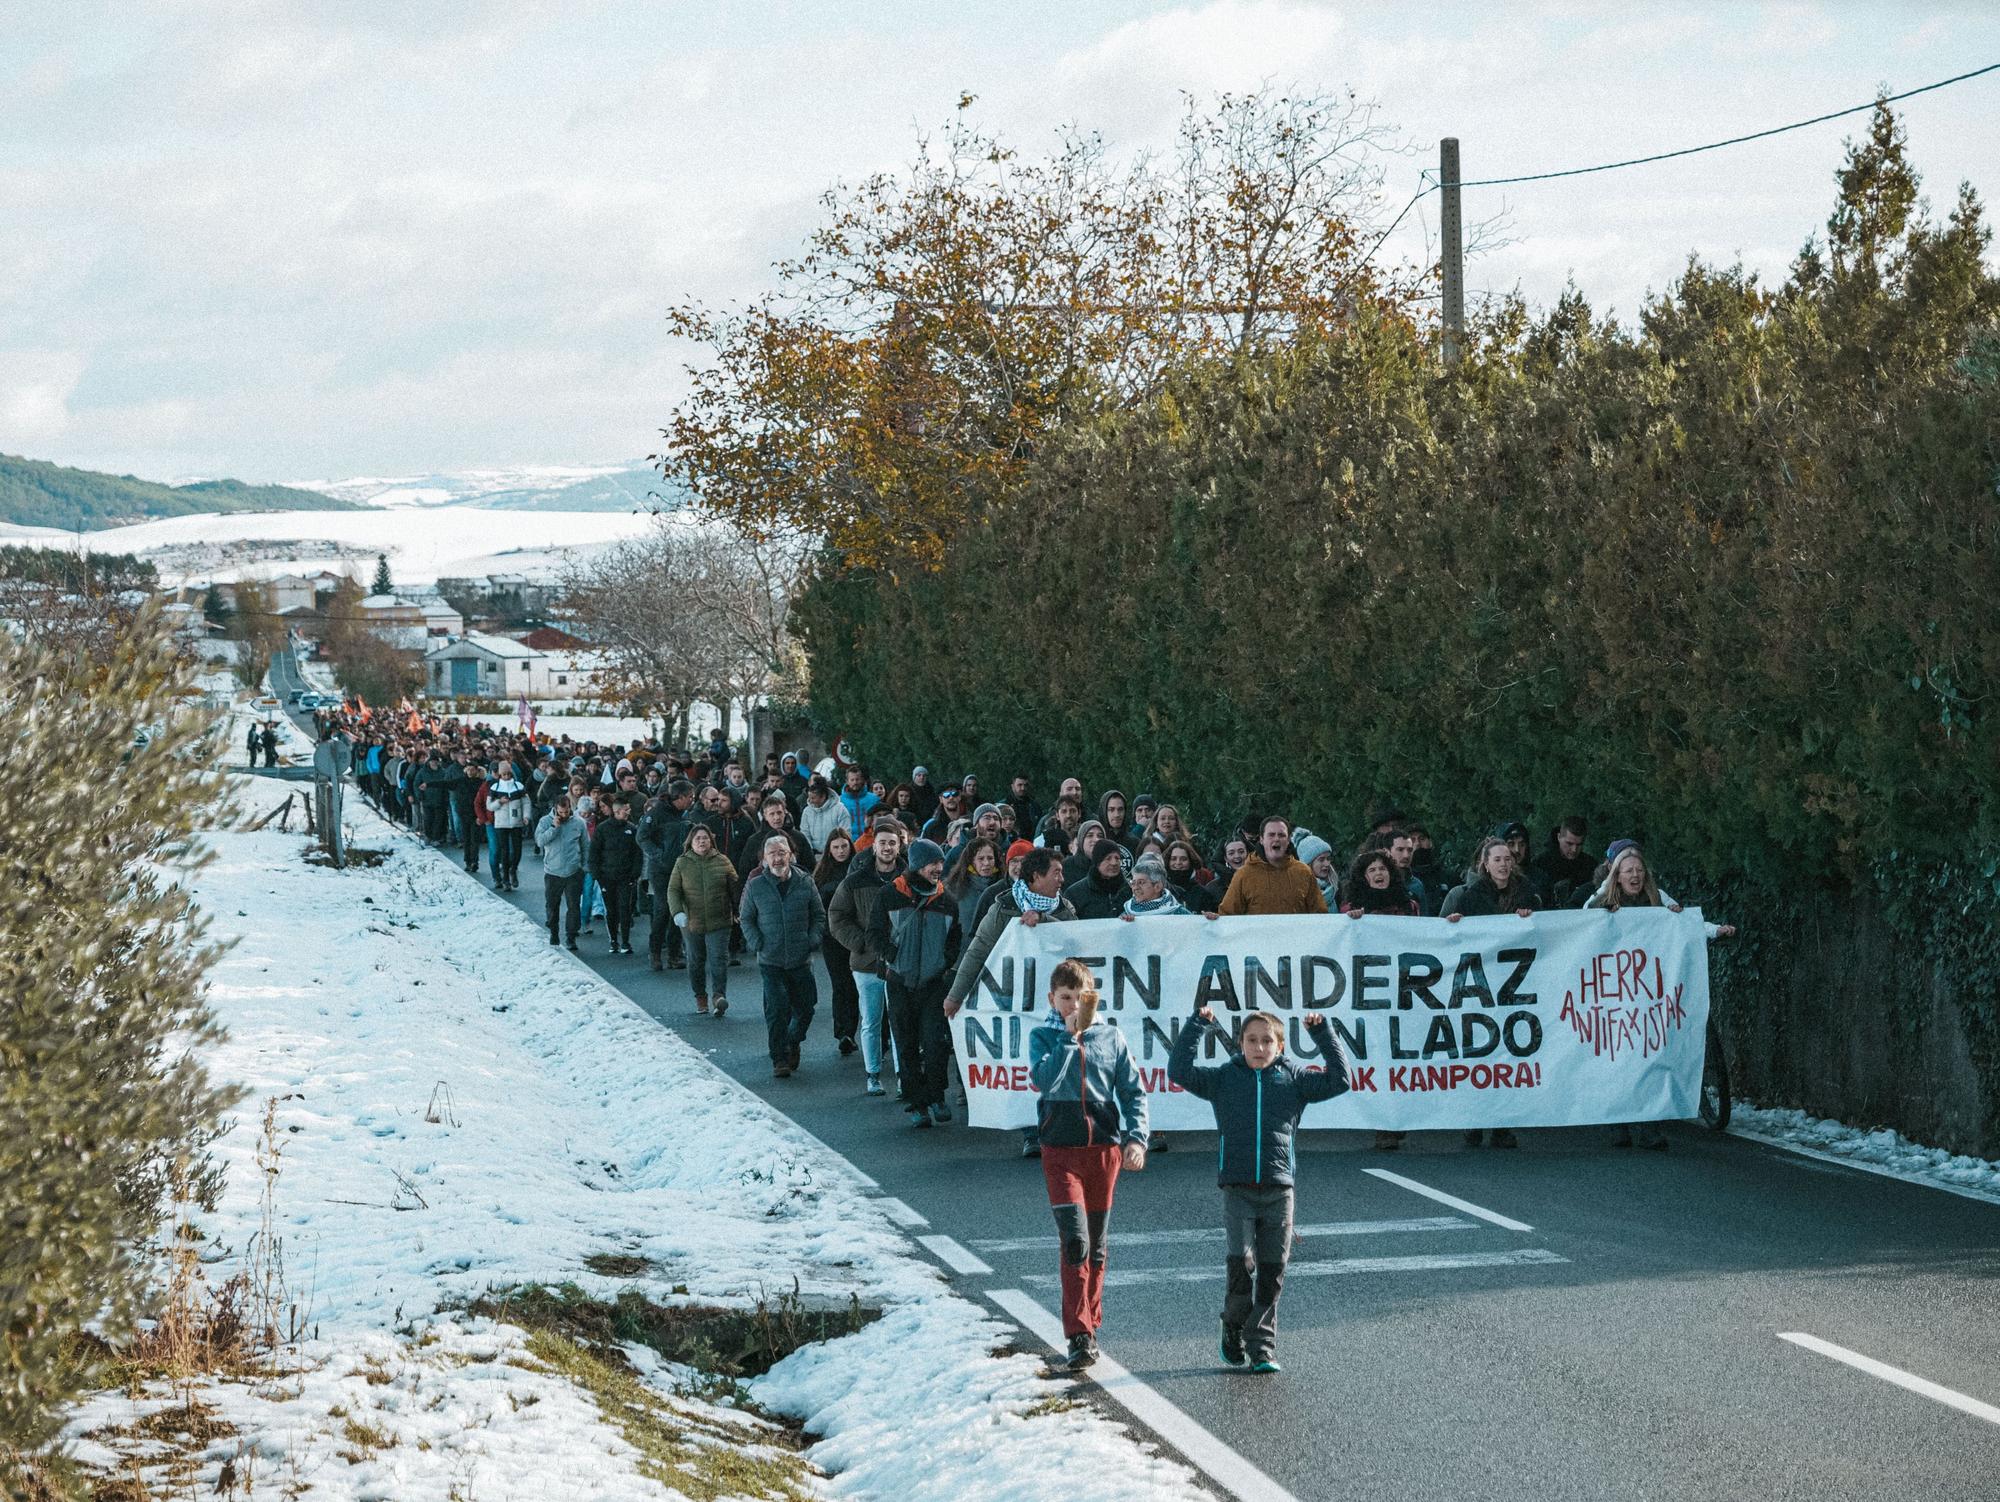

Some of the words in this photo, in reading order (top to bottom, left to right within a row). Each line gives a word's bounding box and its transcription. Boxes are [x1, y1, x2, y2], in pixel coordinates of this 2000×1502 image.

[965, 955, 1036, 1012] NI
[1193, 948, 1537, 1012] ANDERAZ
[1581, 948, 1664, 1004] HERRI
[965, 1015, 1020, 1060] NI
[1143, 1015, 1367, 1060] NNUN
[1389, 1010, 1543, 1060] LADO
[1560, 982, 1687, 1062] ANTIFAXISTAK
[1389, 1062, 1541, 1093] KANPORA!
